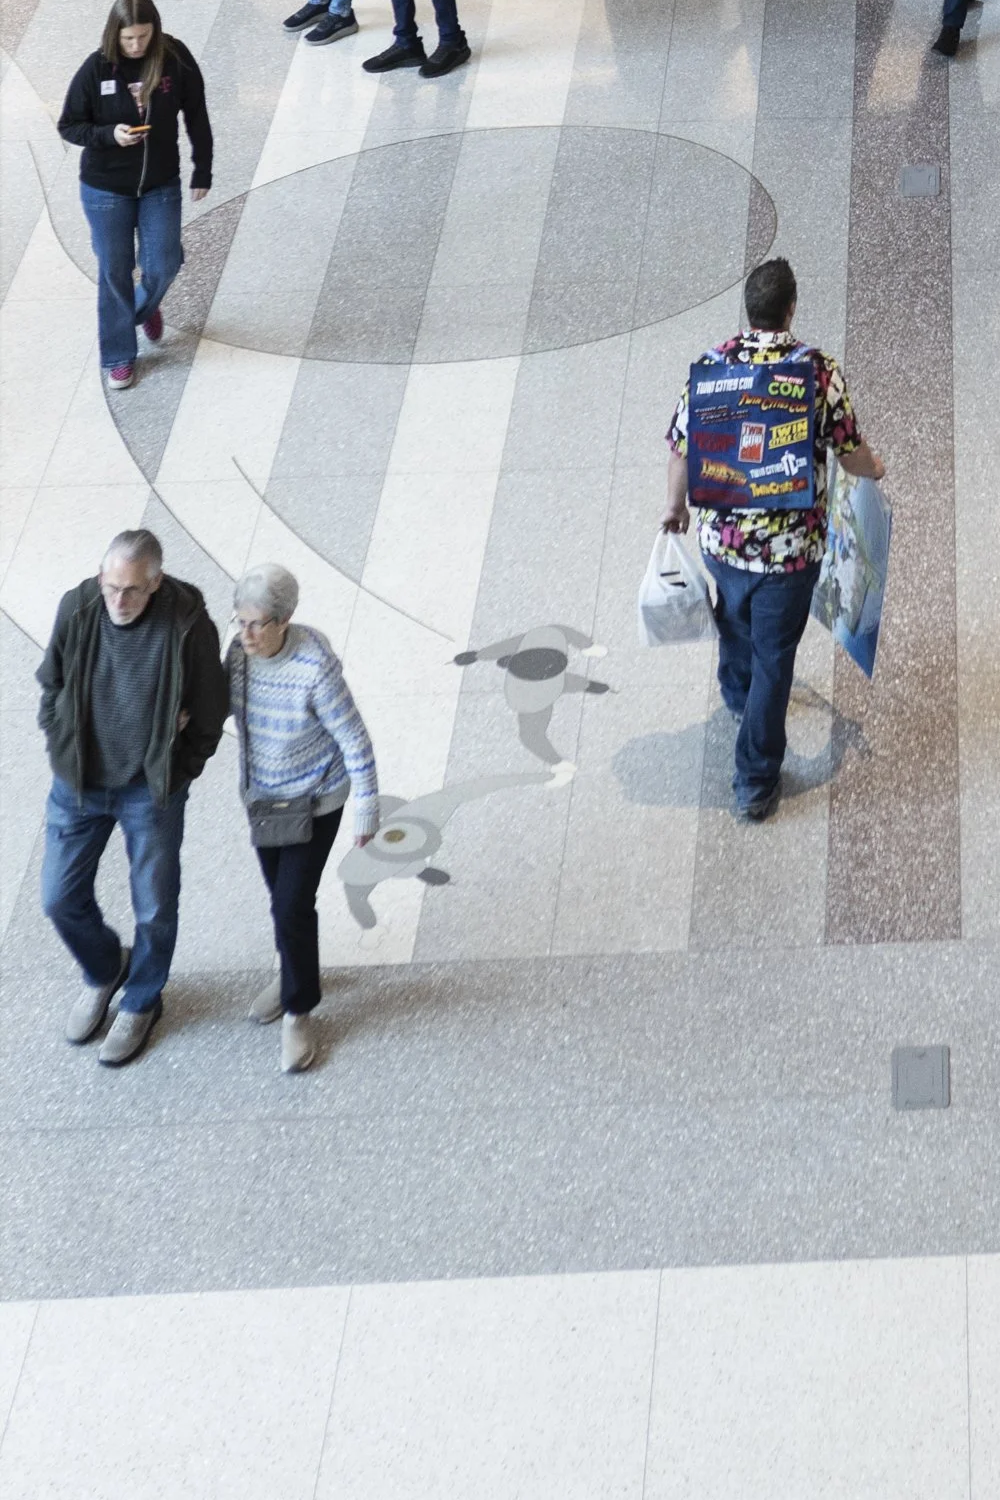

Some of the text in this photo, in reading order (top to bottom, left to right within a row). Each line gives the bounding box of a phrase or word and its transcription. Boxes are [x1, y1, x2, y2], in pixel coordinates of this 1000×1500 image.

[696, 376, 754, 396] TWIN CITIES CON
[767, 381, 806, 400] CON
